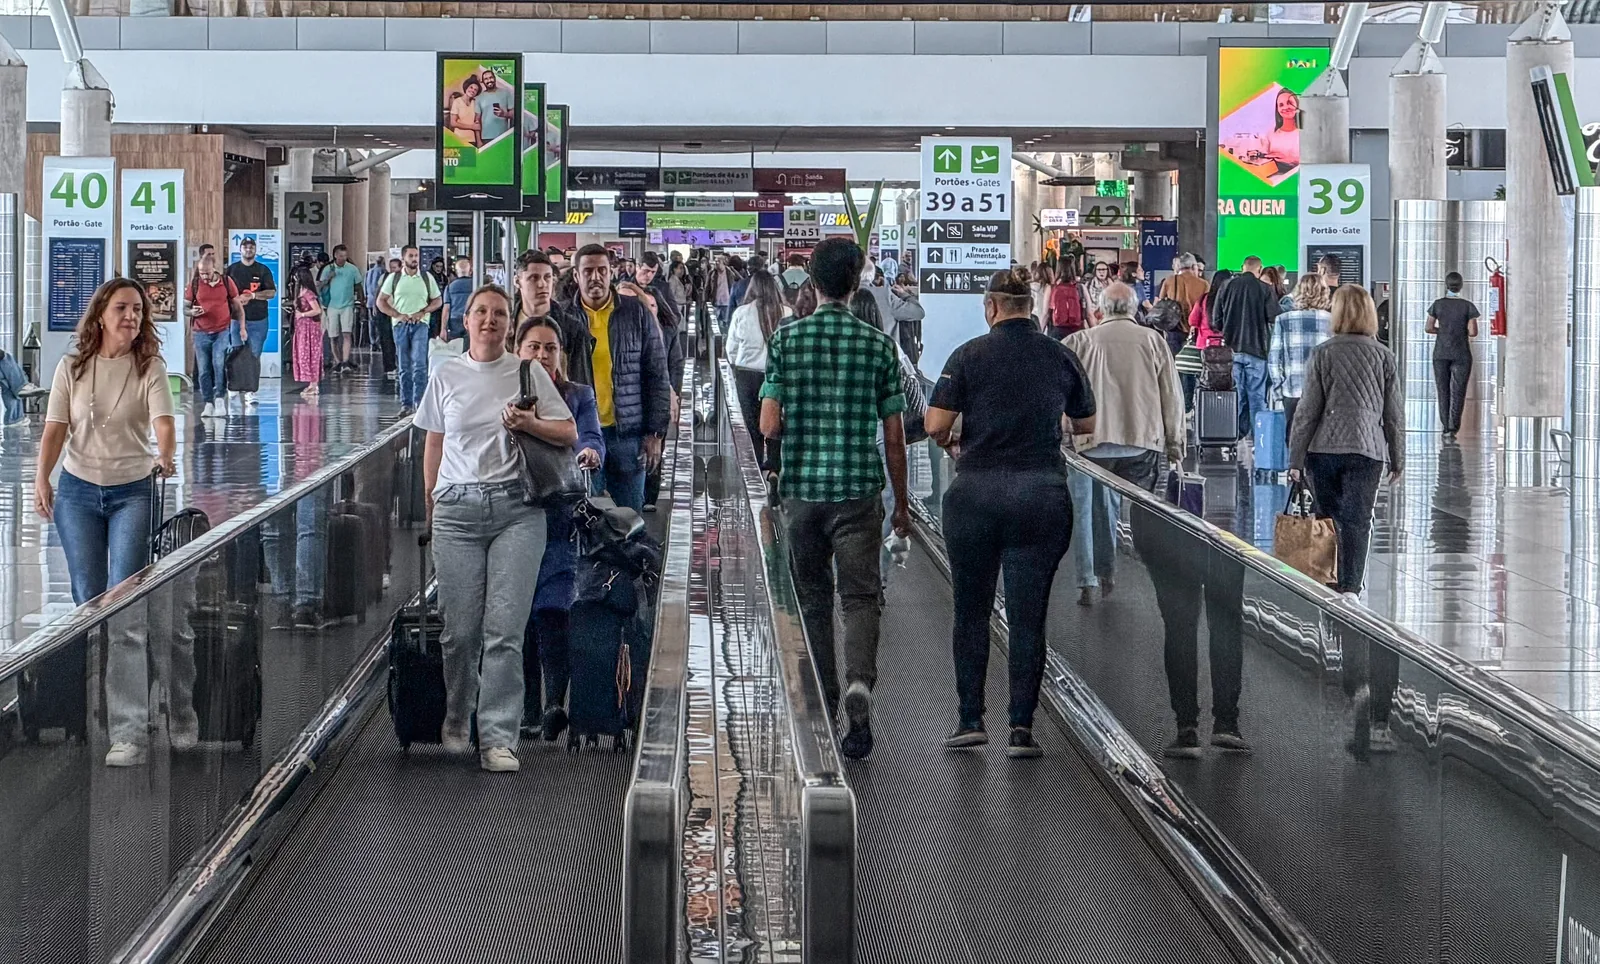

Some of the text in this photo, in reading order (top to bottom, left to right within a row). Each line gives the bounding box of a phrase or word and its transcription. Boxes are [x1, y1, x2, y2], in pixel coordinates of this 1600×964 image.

[935, 177, 1001, 187] Portões Gates
[50, 172, 107, 209] 40
[1308, 178, 1365, 215] 39
[130, 181, 176, 214] 41
[926, 191, 1005, 212] 39 a 51
[289, 201, 325, 224] 43
[1239, 199, 1286, 216] QUEM
[1085, 205, 1121, 226] 42
[53, 219, 80, 227] Portão
[130, 223, 154, 231] Portão
[419, 216, 445, 233] 45
[971, 224, 986, 232] Sala
[787, 228, 799, 236] 44
[808, 228, 819, 236] 51
[881, 229, 899, 241] 50
[1311, 226, 1338, 234] Portão
[1144, 235, 1175, 246] ATM
[965, 252, 1007, 260] Alimentação
